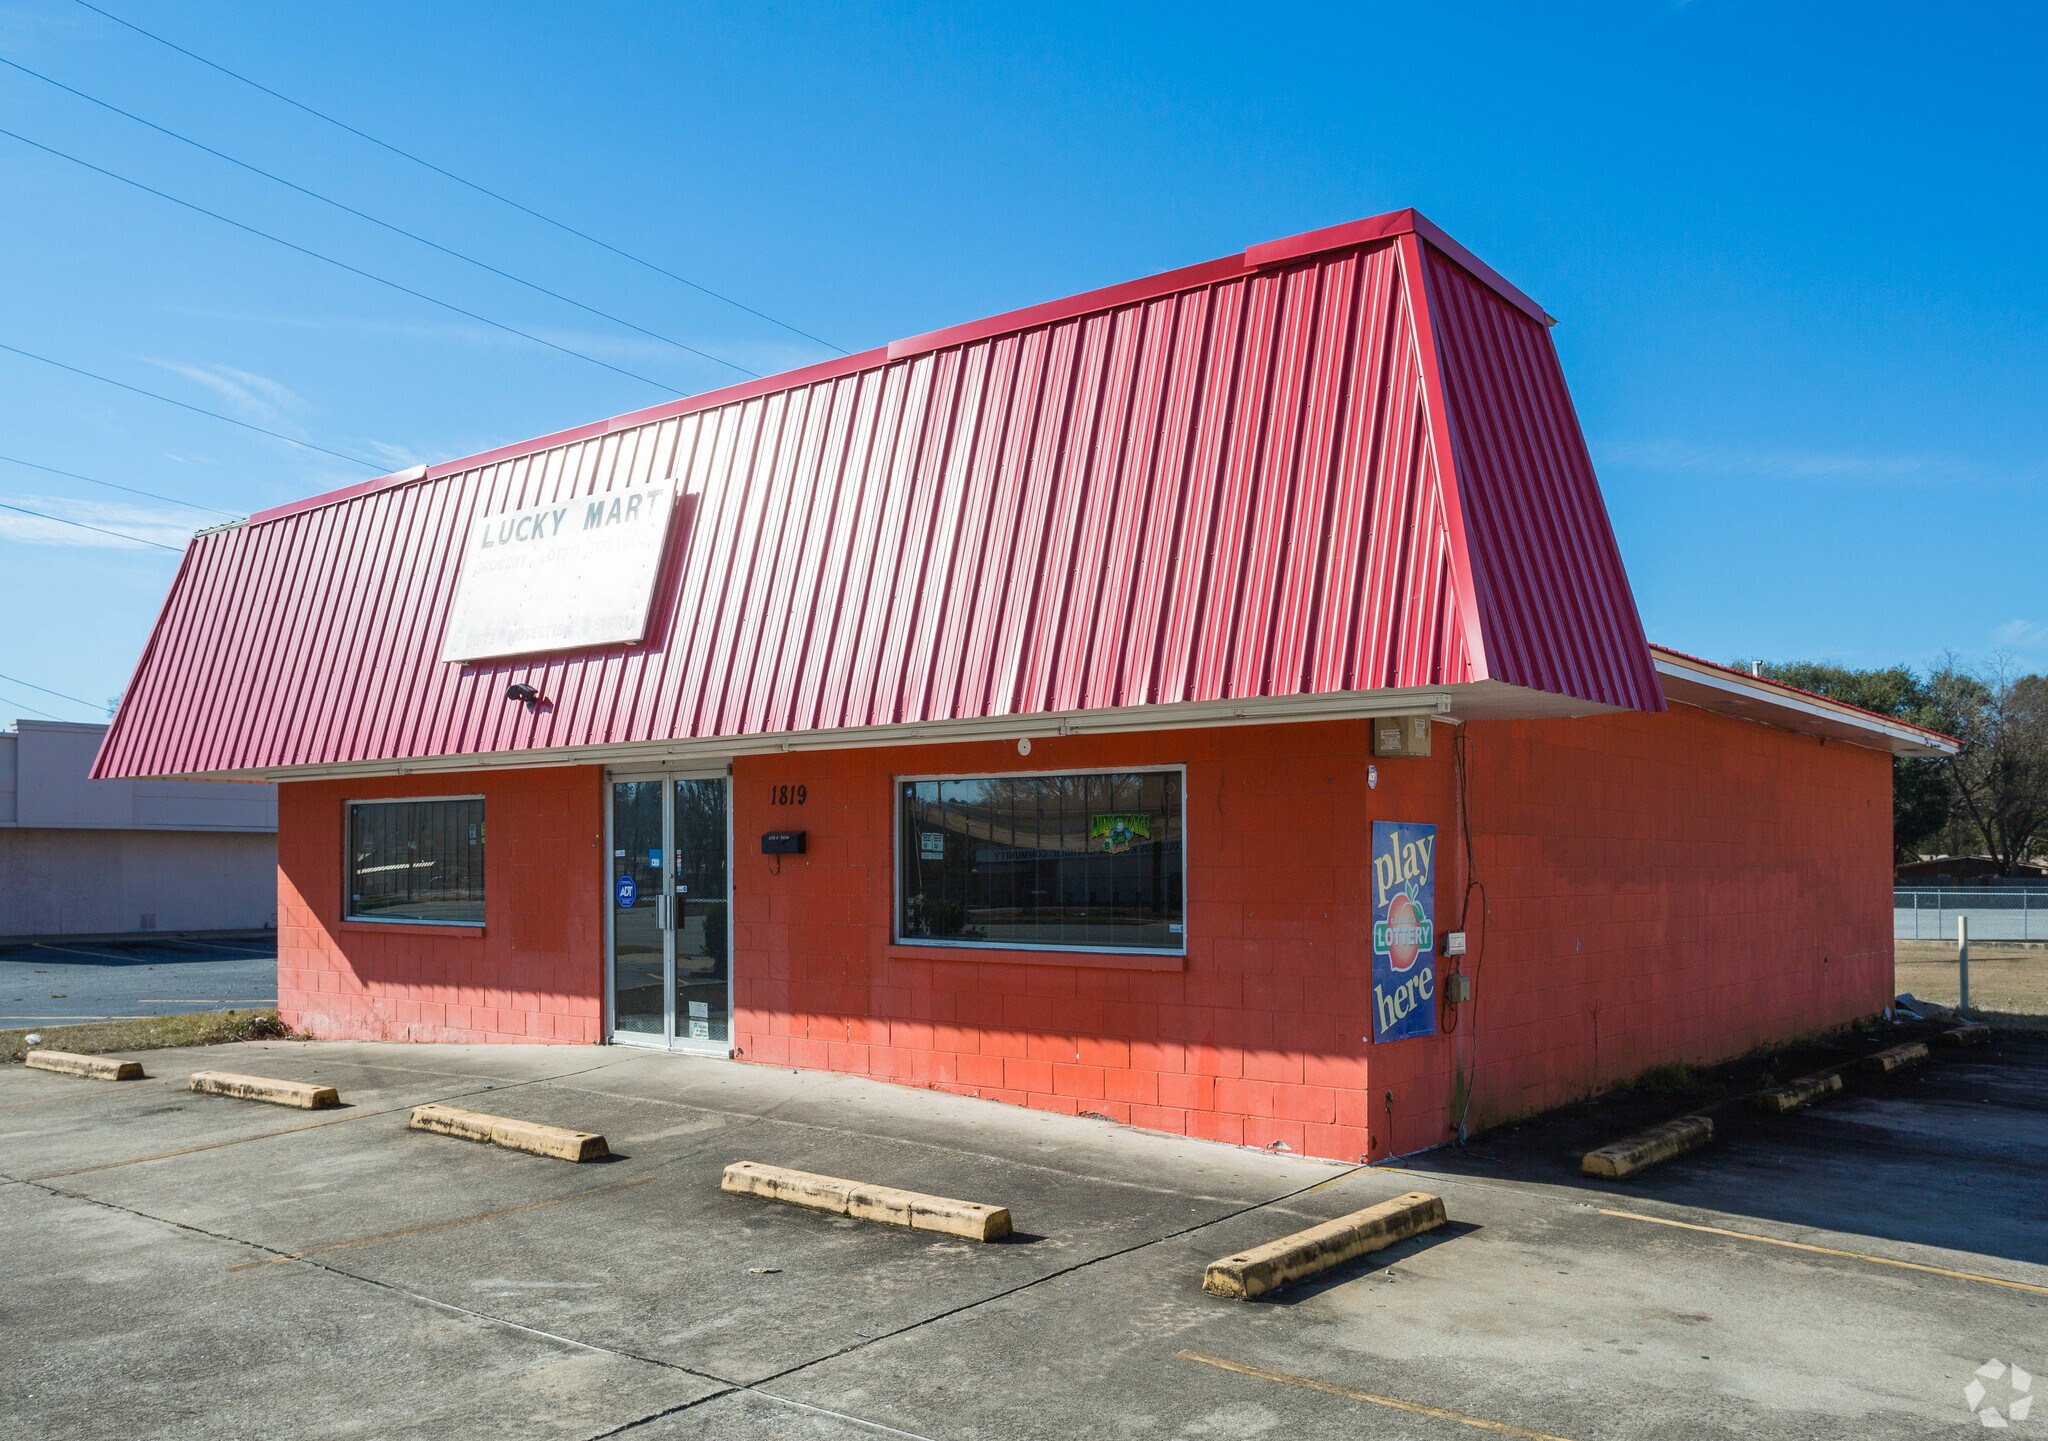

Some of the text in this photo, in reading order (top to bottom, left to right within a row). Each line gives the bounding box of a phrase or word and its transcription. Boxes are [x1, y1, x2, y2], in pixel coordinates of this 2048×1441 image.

[481, 488, 664, 550] LUCKY MART
[770, 784, 807, 806] 1819
[1374, 831, 1435, 908] play
[620, 885, 633, 897] ADT
[1377, 926, 1430, 947] LOTTERY
[1374, 966, 1434, 1035] here
